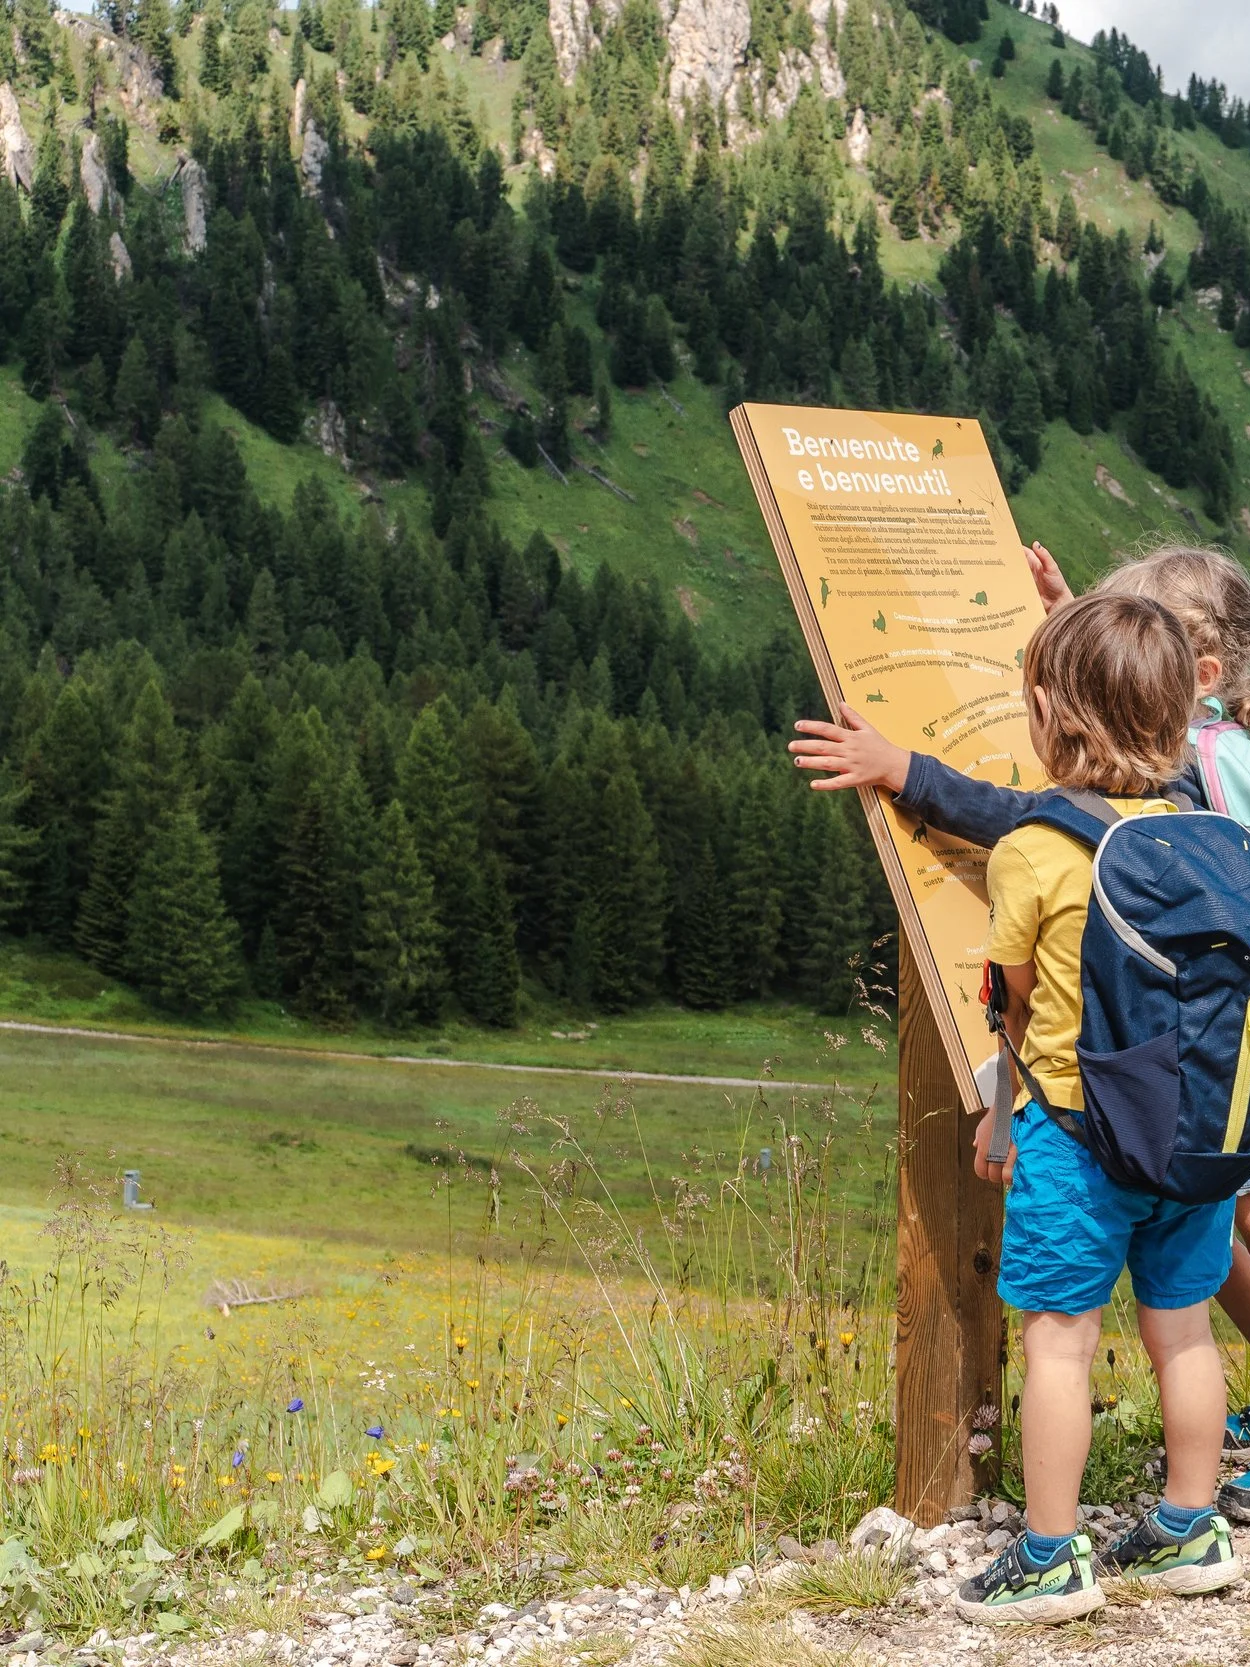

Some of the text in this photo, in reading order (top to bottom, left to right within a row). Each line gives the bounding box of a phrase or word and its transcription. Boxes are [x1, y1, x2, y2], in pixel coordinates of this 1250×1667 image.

[782, 427, 920, 463] Benvenute
[798, 463, 952, 496] e benvenuti!
[806, 502, 818, 510] Stai
[819, 504, 829, 512] per
[829, 502, 860, 511] cominciare
[872, 504, 899, 514] magnifica
[926, 506, 937, 514] alla
[938, 508, 962, 516] scoperta
[961, 507, 976, 516] degli
[810, 513, 826, 521] mali
[837, 514, 857, 522] vivono
[867, 515, 886, 524] queste
[886, 516, 917, 525] montagne.
[929, 518, 948, 526] sempre
[967, 517, 984, 525] vederli
[818, 535, 840, 543] chiome
[840, 535, 854, 545] degli
[854, 536, 872, 544] alberi,
[952, 537, 969, 545] radici,
[837, 546, 881, 554] silenziosamente
[891, 546, 909, 554] boschi
[915, 547, 938, 555] conifere.
[901, 557, 920, 565] bosco
[959, 558, 984, 566] numerosi
[984, 558, 1006, 566] animali,
[840, 567, 857, 575] anche
[857, 567, 863, 575] di
[863, 567, 885, 576] piante,
[885, 567, 891, 575] di
[891, 568, 916, 576] muschi,
[920, 568, 941, 577] funghi
[950, 568, 964, 576] fiori.
[837, 589, 847, 597] Per
[848, 589, 867, 598] questo
[921, 589, 938, 598] questi
[938, 588, 960, 598] consigli:
[970, 614, 987, 623] vorrai
[987, 613, 1000, 621] mica
[999, 605, 1027, 619] spaventare
[918, 625, 950, 634] passerotto
[950, 627, 972, 635] appena
[971, 624, 989, 632] uscito
[989, 618, 1015, 631] dall'uovo?
[844, 661, 855, 671] Fai
[854, 653, 885, 667] attenzione
[954, 651, 974, 660] anche
[983, 656, 1014, 672] fazzoletto
[851, 673, 858, 682] di
[857, 669, 873, 680] carta
[872, 664, 896, 674] impiega
[895, 660, 926, 669] tantissimo
[926, 660, 946, 668] tempo
[945, 660, 963, 669] prima
[964, 661, 970, 669] di
[941, 715, 950, 723] Se
[949, 702, 969, 718] incontri
[968, 695, 990, 709] qualche
[989, 691, 1010, 701] animale
[967, 714, 976, 722] ma
[975, 709, 986, 718] non
[942, 738, 960, 755] ricorda
[959, 732, 969, 742] che
[968, 726, 979, 736] non
[982, 715, 1004, 729] abituato
[936, 848, 955, 857] bosco
[955, 847, 972, 856] parla
[972, 848, 989, 856] tante
[923, 876, 945, 888] queste
[966, 945, 984, 955] Prend
[954, 961, 984, 970] nel bosco
